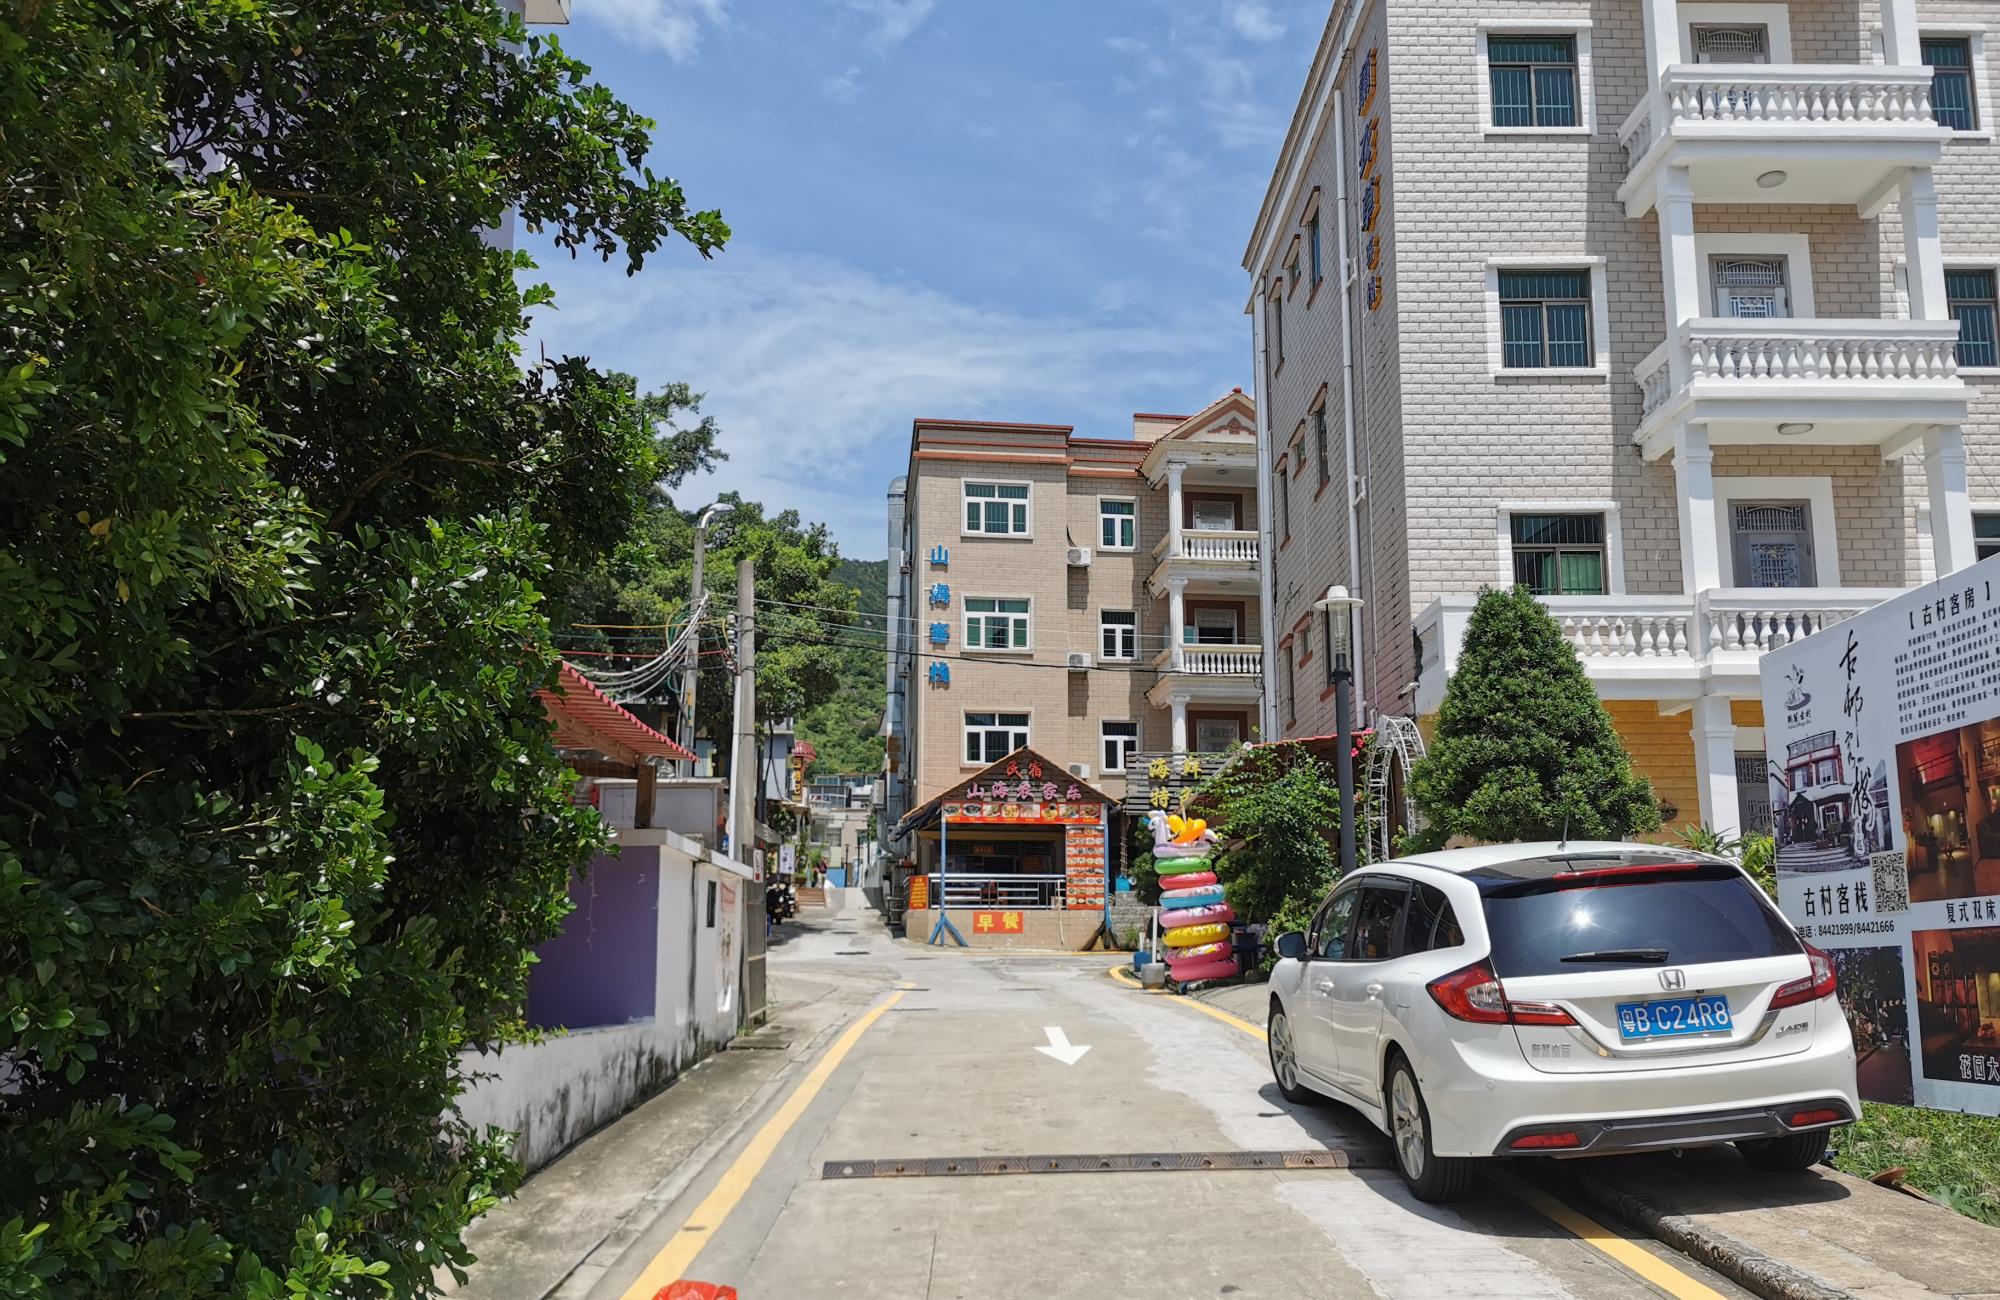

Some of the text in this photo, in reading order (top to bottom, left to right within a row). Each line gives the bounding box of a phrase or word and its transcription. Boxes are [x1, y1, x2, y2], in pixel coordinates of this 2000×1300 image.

[1006, 760, 1044, 780] 民宿
[1148, 754, 1202, 780] 海鲜
[966, 780, 1082, 801] 山海农家乐
[1803, 881, 1869, 917] 古村客栈
[977, 911, 1020, 932] 早餐
[1946, 899, 1996, 924] 复式双床
